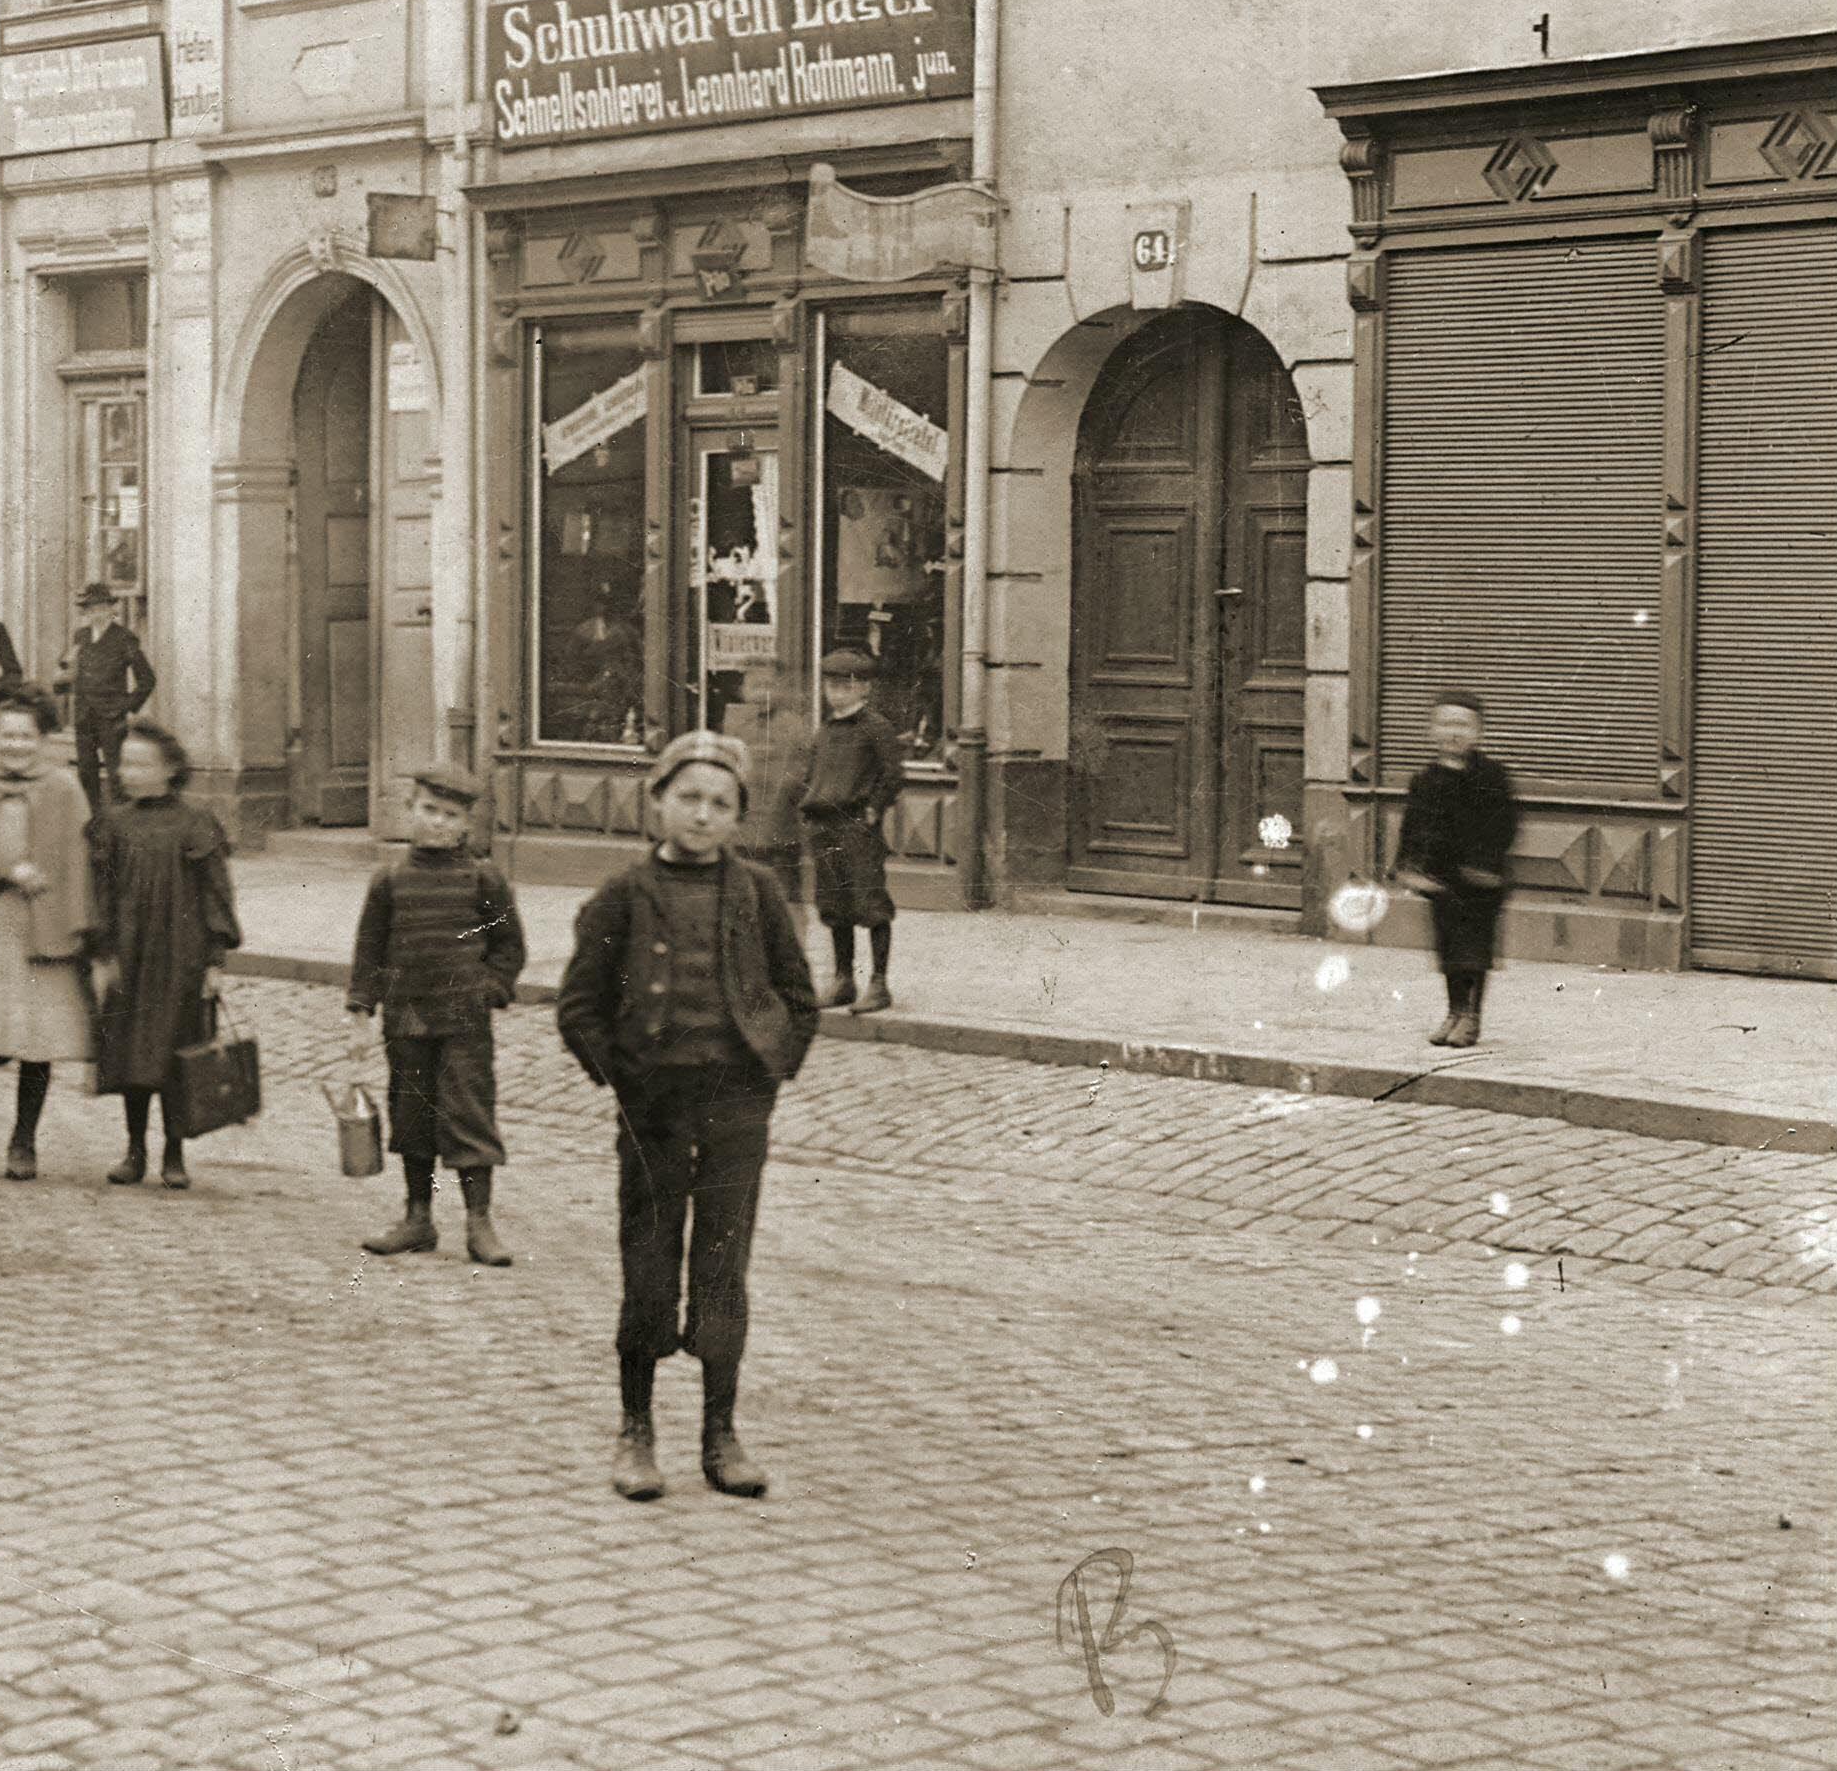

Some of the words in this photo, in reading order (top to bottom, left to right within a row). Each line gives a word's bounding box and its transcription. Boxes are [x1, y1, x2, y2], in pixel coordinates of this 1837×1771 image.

[494, 66, 665, 140] Schnellsohlerei
[678, 46, 791, 117] Leonhard
[912, 35, 957, 92] jun.
